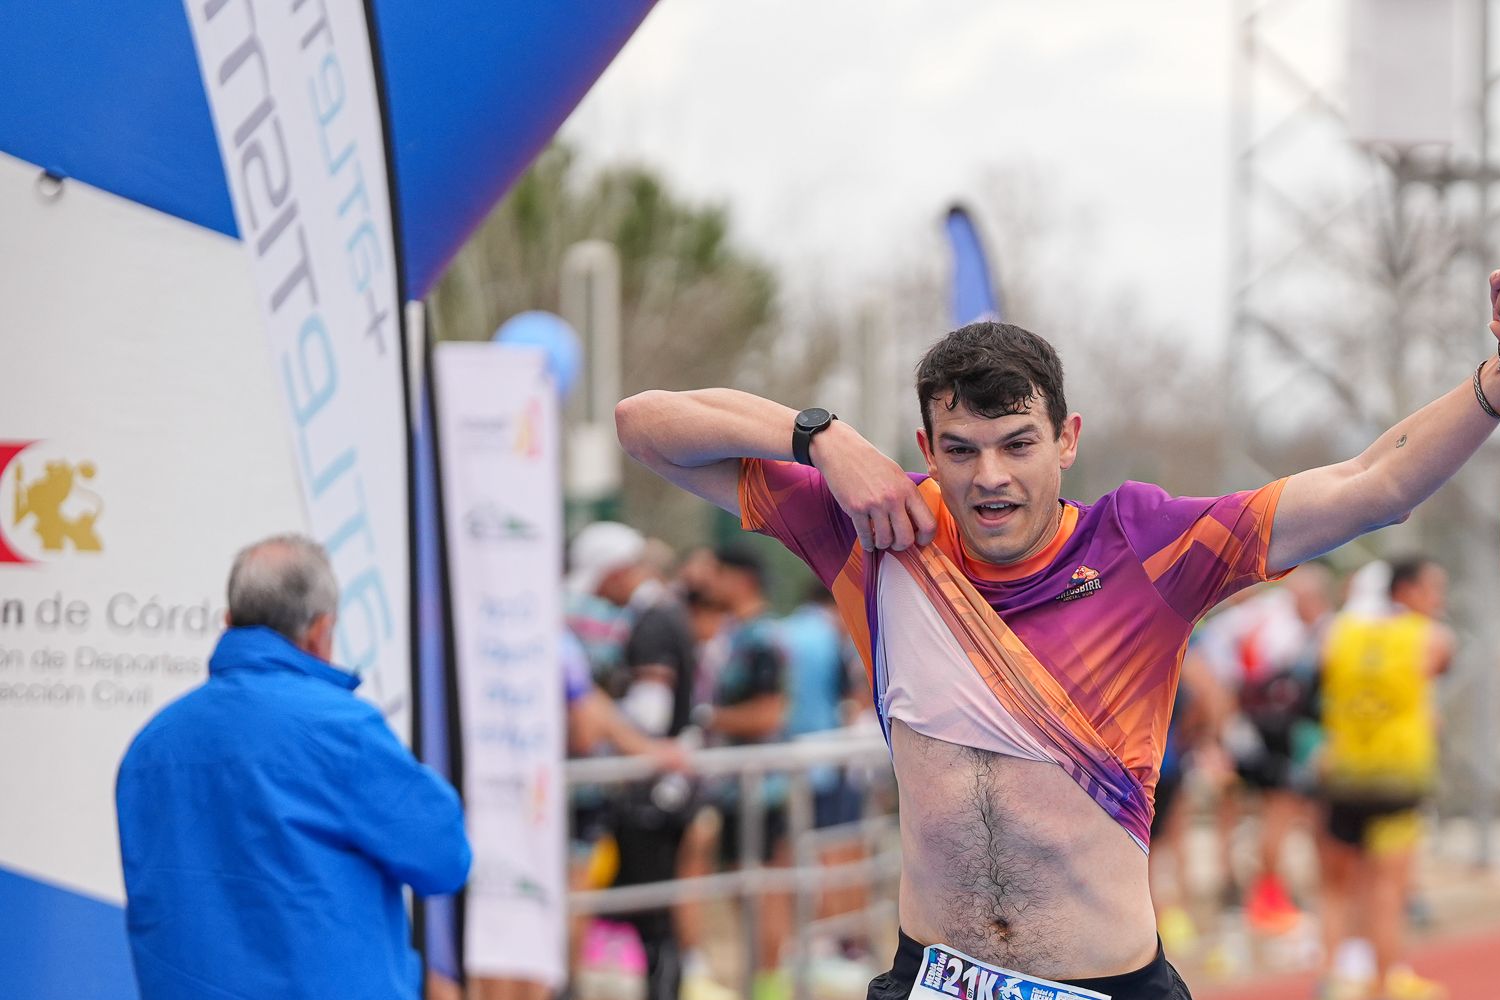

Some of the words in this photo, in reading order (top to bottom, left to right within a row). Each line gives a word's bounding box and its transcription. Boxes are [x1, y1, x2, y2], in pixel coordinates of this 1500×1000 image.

[36, 590, 90, 629] de
[31, 646, 66, 670] de
[76, 647, 202, 676] Deportes
[924, 963, 937, 986] MEDIA
[932, 952, 948, 989] MARATÓN
